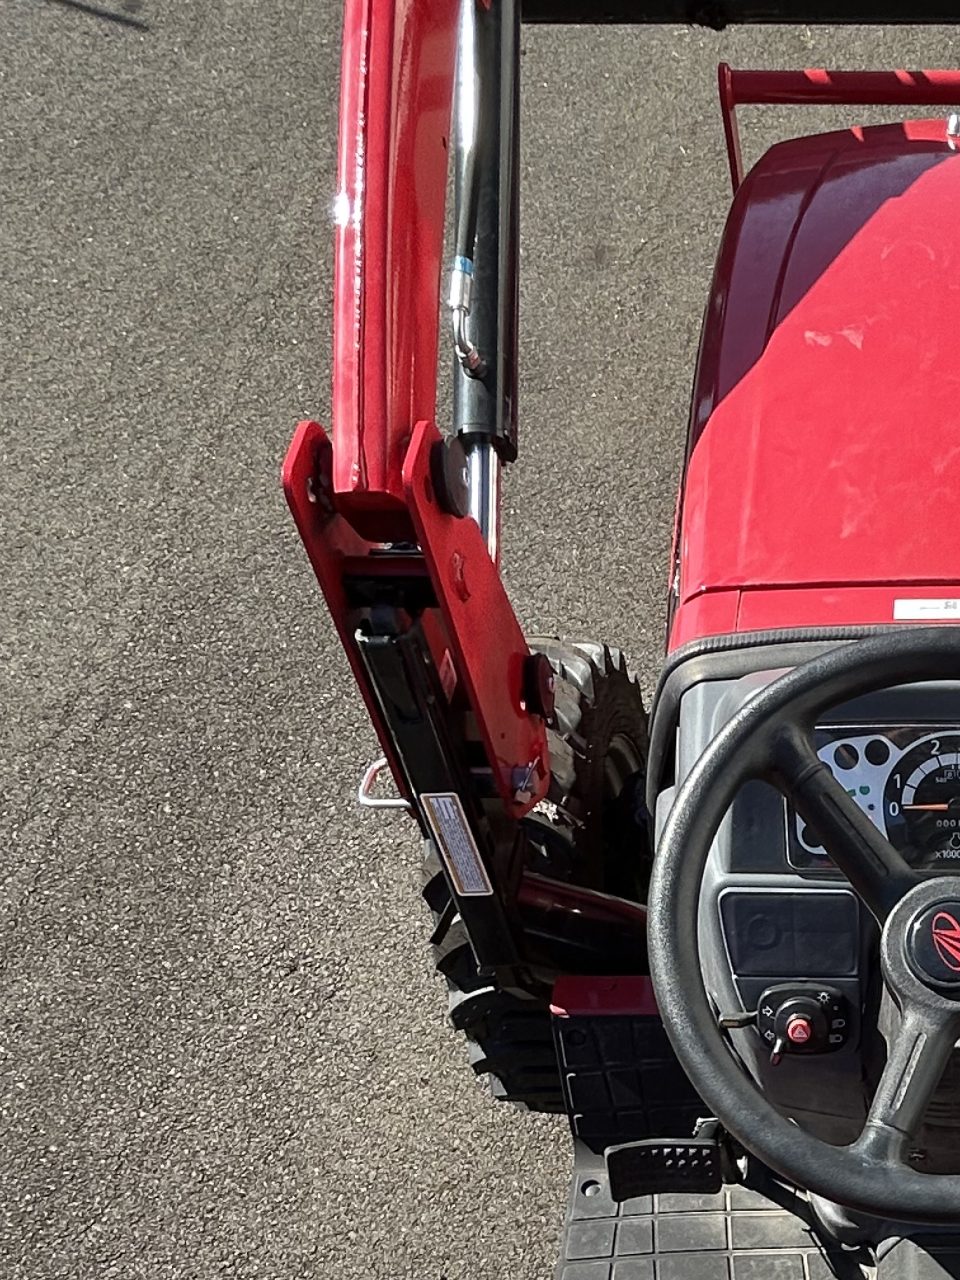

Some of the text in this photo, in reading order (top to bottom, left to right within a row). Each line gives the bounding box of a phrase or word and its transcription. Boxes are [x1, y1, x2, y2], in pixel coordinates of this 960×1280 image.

[930, 740, 940, 755] 2
[893, 774, 901, 789] 1
[889, 802, 899, 817] 0
